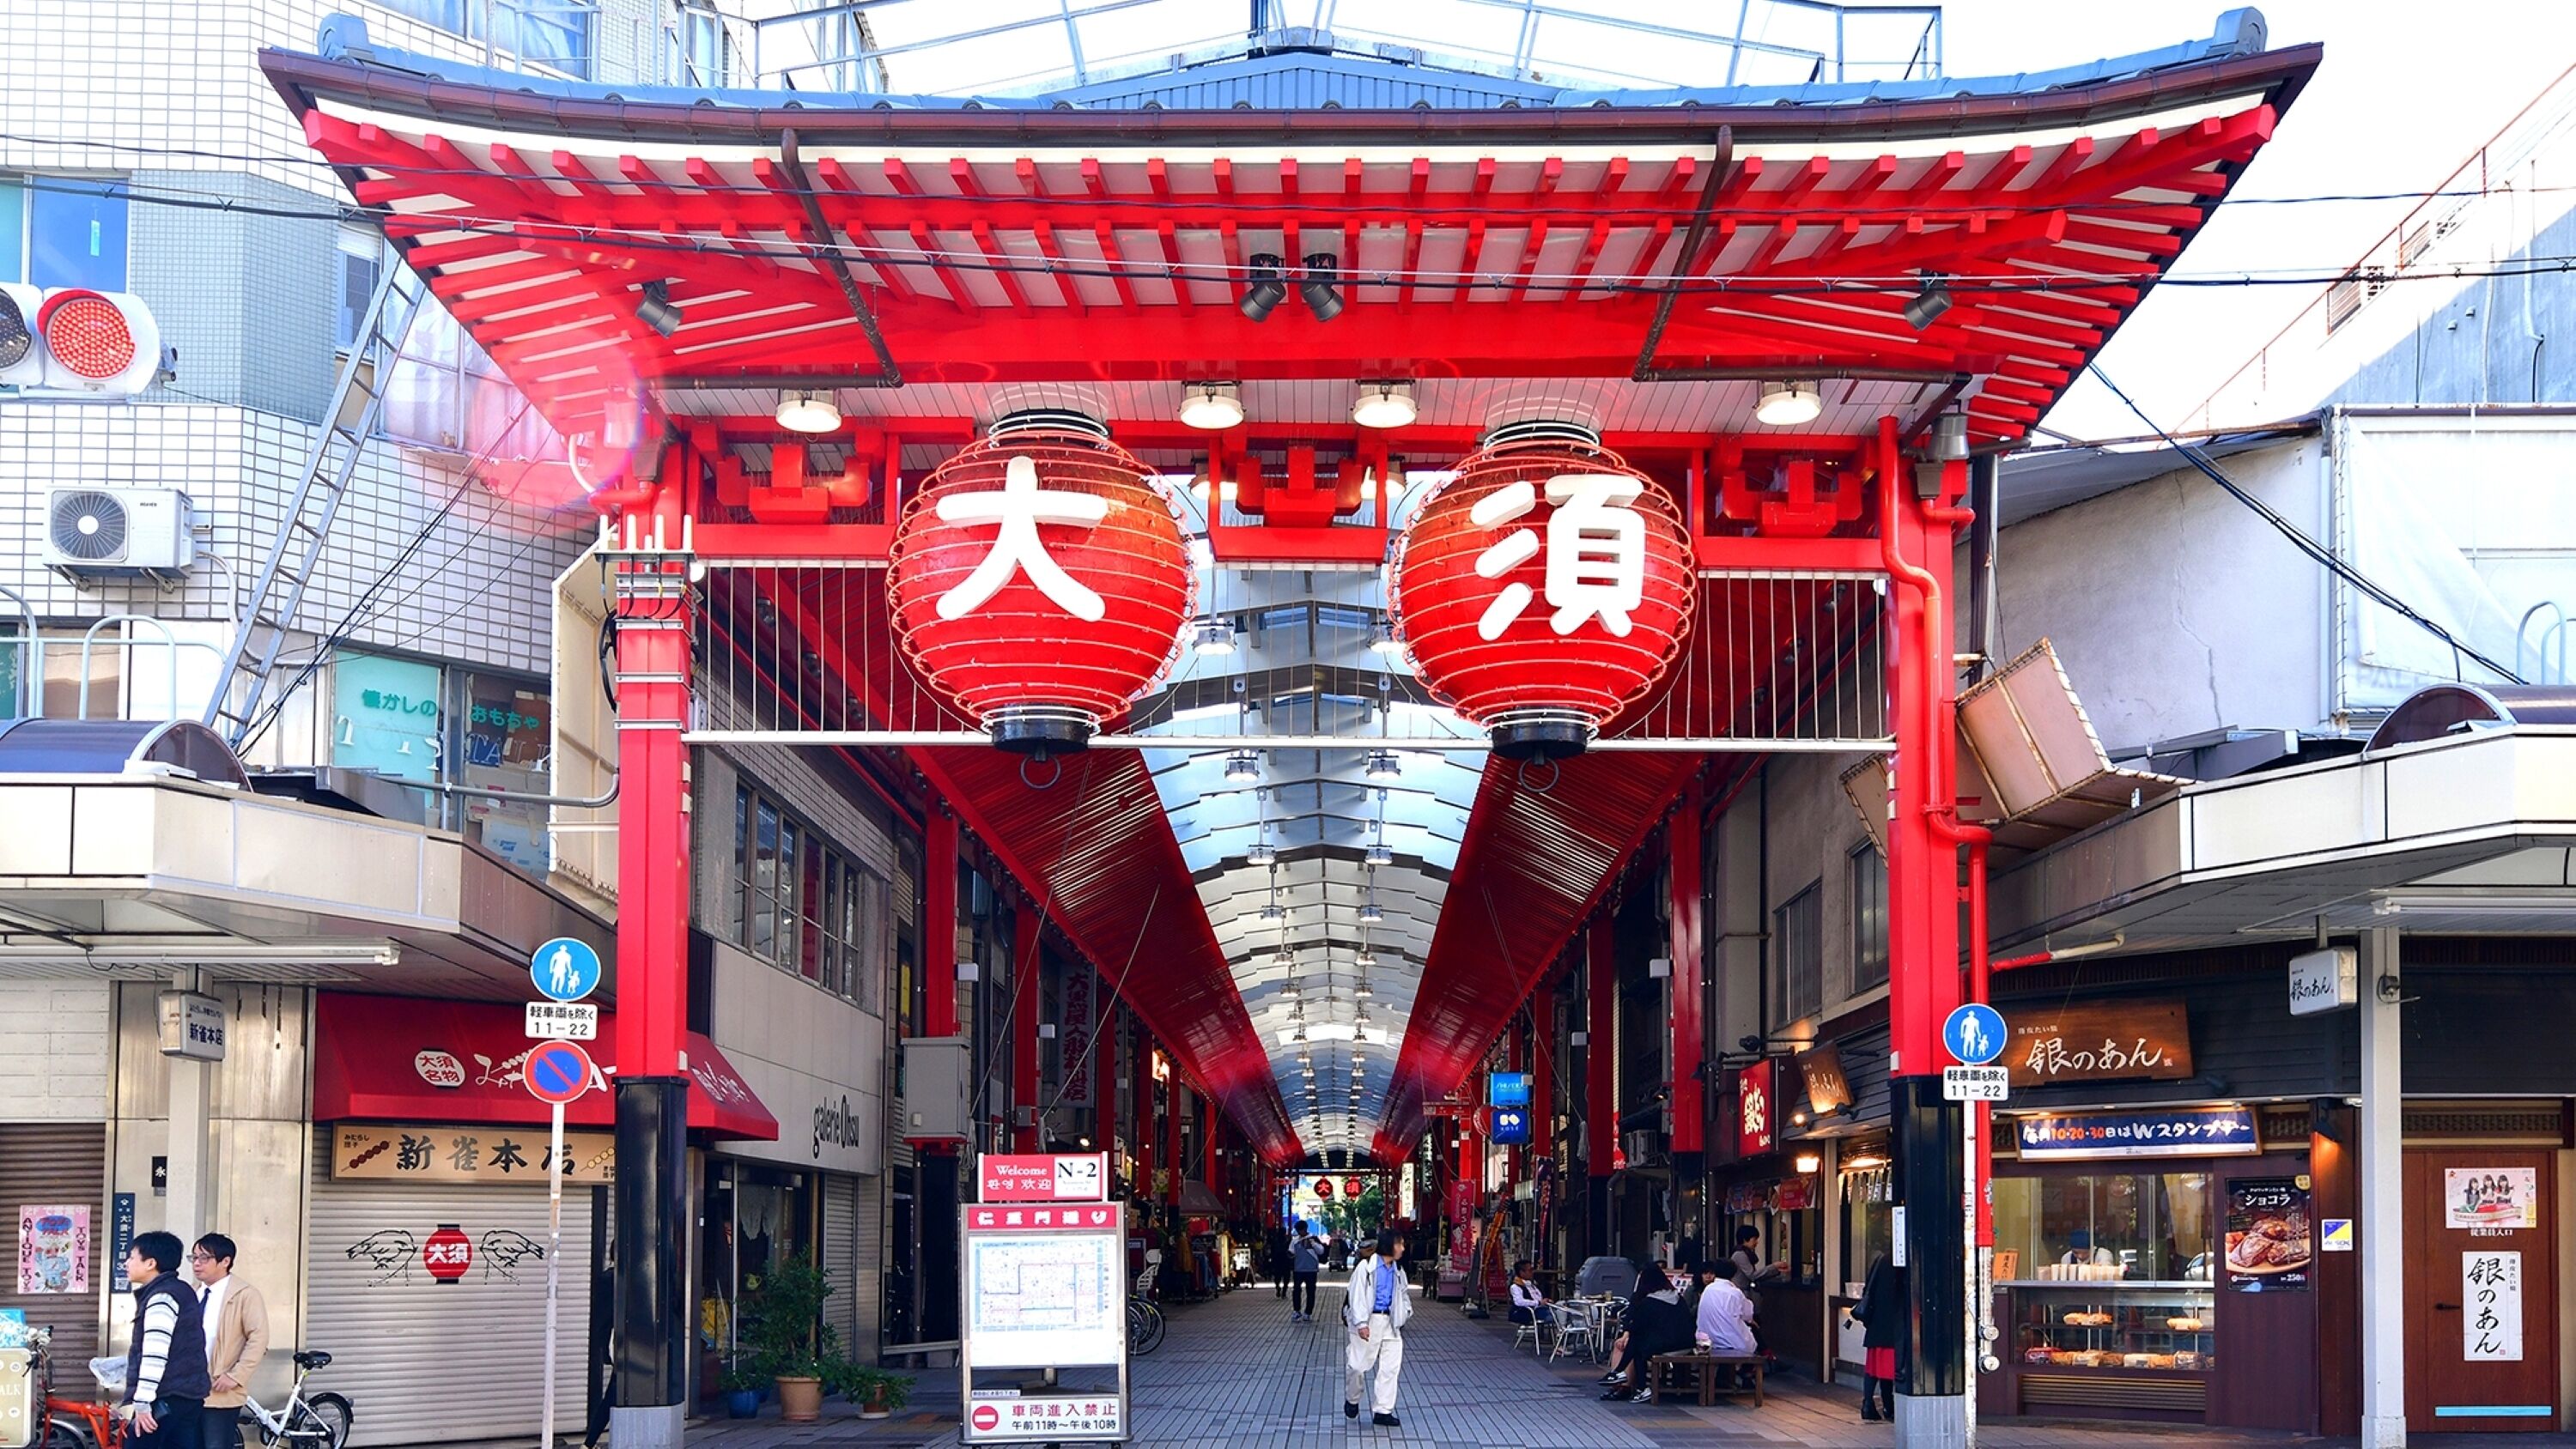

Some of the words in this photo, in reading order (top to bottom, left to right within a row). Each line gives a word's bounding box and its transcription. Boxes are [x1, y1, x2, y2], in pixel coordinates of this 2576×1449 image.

[936, 456, 1109, 623] 大
[1469, 473, 1644, 640] 須
[470, 705, 540, 730] おもちゃ
[530, 1006, 593, 1020] 軽車両を除く
[419, 1054, 454, 1070] 大須
[2026, 1037, 2162, 1075] 銀のあん
[425, 1067, 460, 1082] 名物
[1947, 1070, 2005, 1081] 軽車両を除く
[396, 1134, 575, 1175] 新雀本店
[995, 1164, 1048, 1175] Welcome
[1057, 1161, 1097, 1178] N-2
[987, 1179, 1014, 1191] 환영
[1021, 1179, 1052, 1191] 欢迎
[1317, 1182, 1330, 1193] 大
[2245, 1194, 2291, 1206] ショコラ
[428, 1243, 469, 1264] 大須
[75, 1256, 86, 1282] TALK
[2467, 1257, 2506, 1355] 銀のあん
[1012, 1404, 1116, 1417] 車両進入禁止
